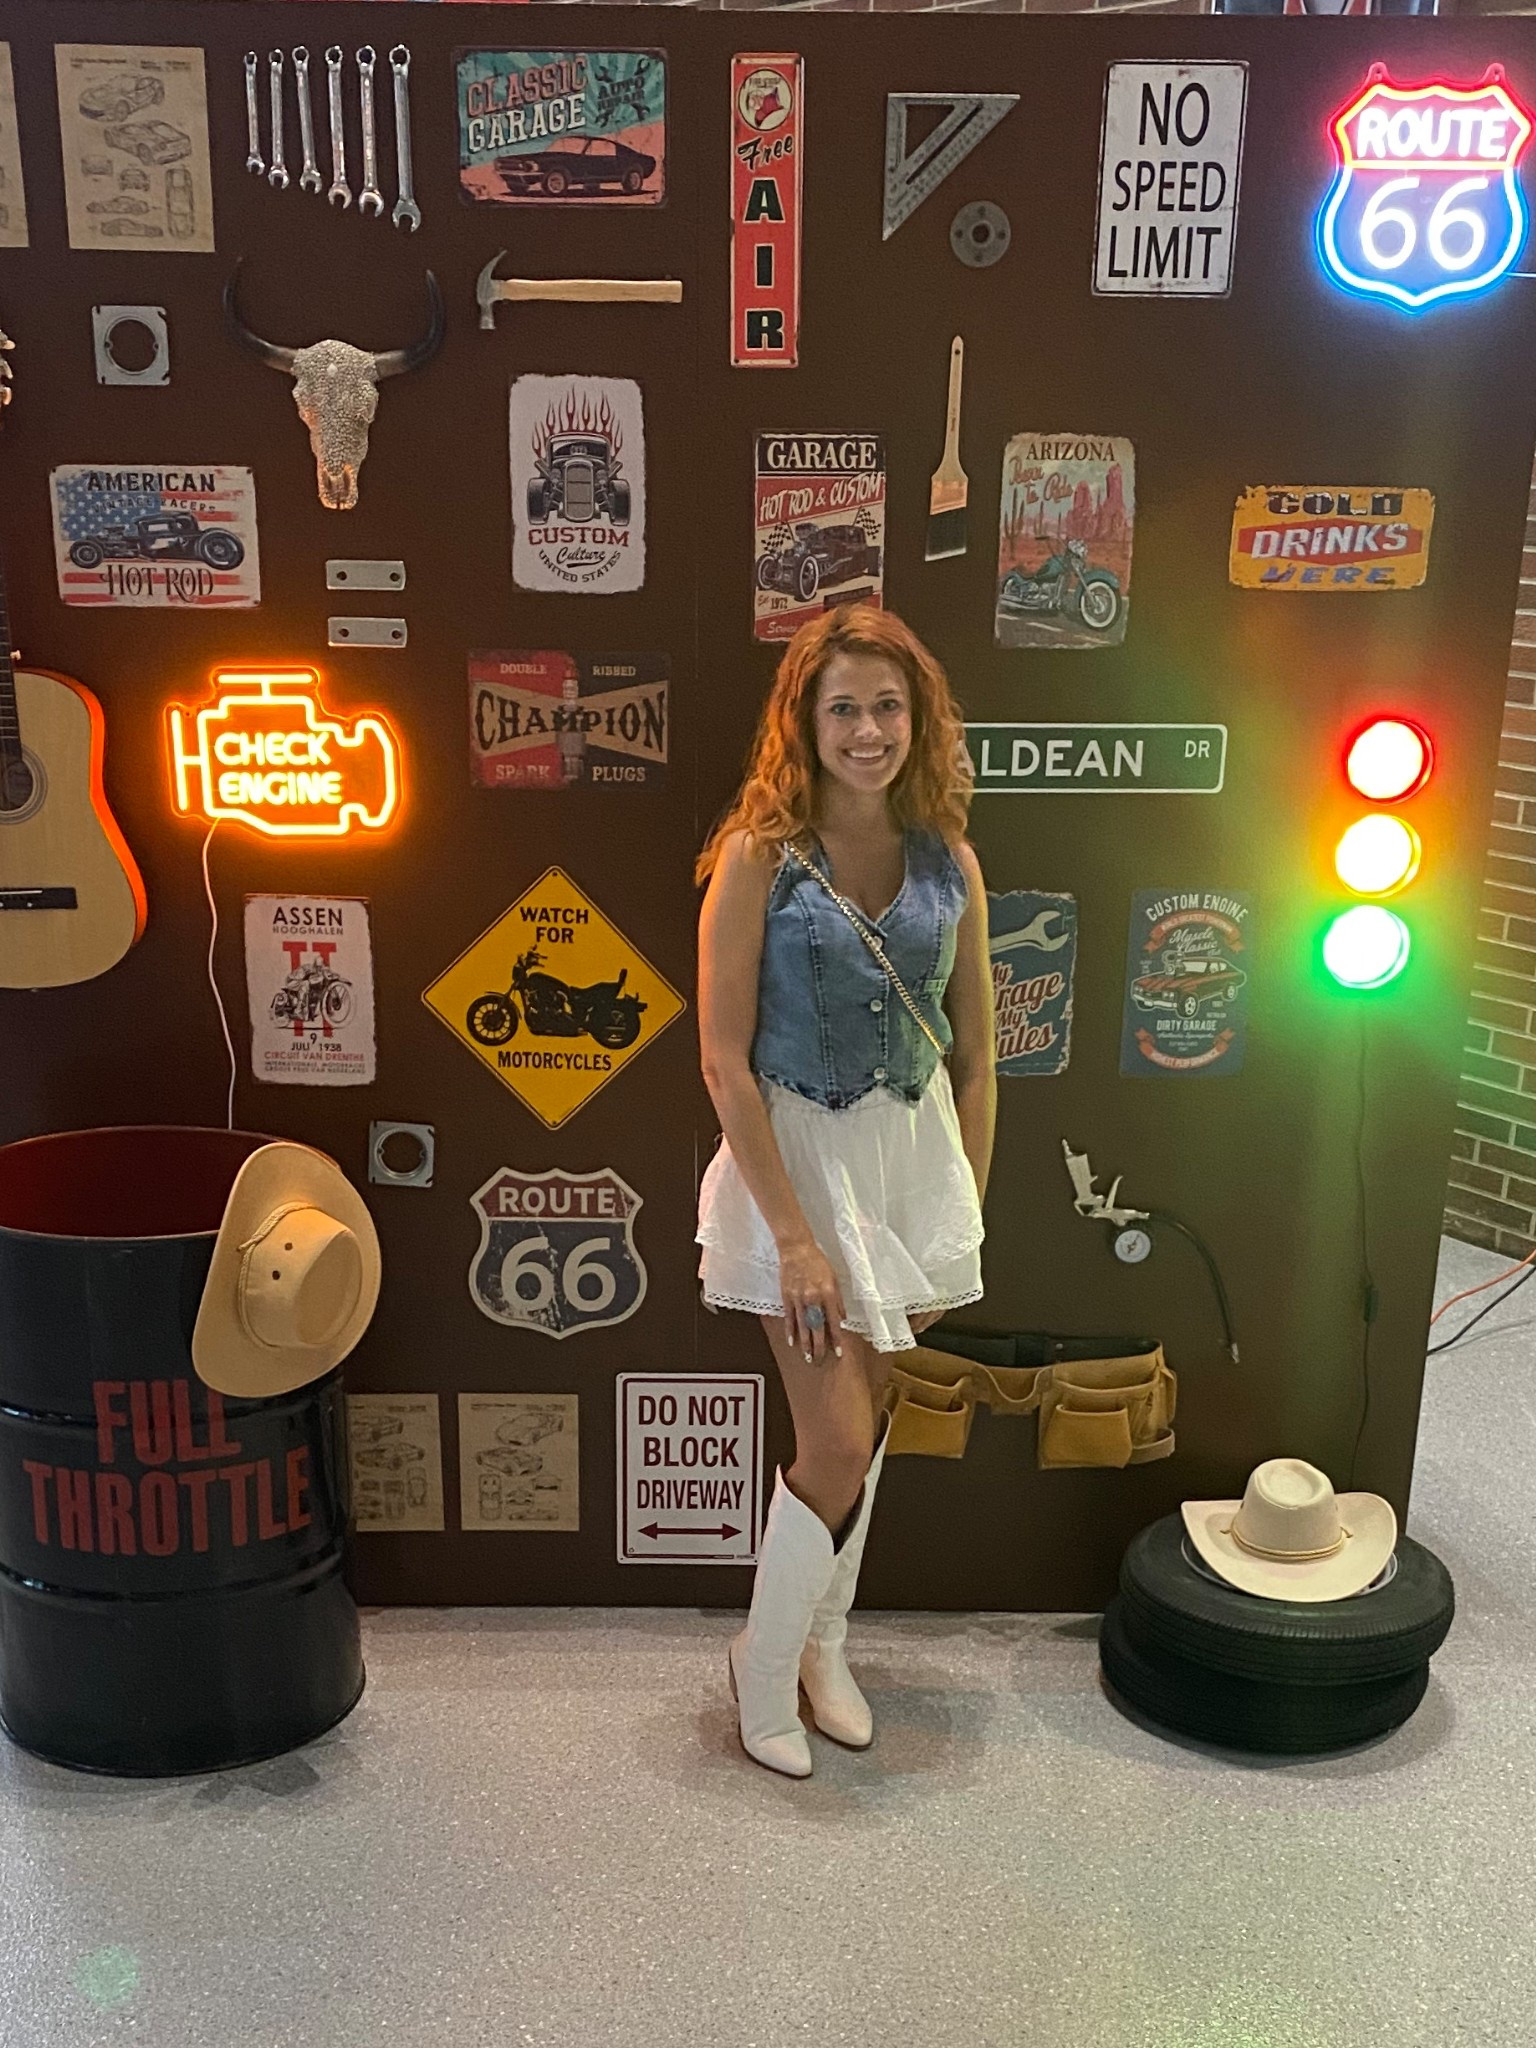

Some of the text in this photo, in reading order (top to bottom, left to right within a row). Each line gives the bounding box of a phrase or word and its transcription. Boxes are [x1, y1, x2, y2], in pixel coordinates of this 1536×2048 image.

[467, 57, 588, 118] CLASSIC
[467, 92, 587, 153] GARAGE
[1138, 82, 1210, 147] NO
[1356, 107, 1510, 158] ROUTE
[737, 136, 793, 170] Free
[1112, 160, 1227, 212] SPEED
[1360, 176, 1489, 270] 66
[744, 178, 785, 349] AIR
[1107, 225, 1222, 279] LIMIT
[766, 441, 877, 469] GARAGE
[1026, 442, 1116, 461] ARIZONA
[87, 472, 216, 492] AMERICAN
[759, 471, 885, 522] HOT ROD & CUSTOM
[160, 498, 216, 514] RACERS
[528, 526, 631, 547] CUSTOM
[1251, 522, 1409, 559] DRINKS
[539, 549, 621, 582] UNITED STATES
[556, 546, 606, 566] Culture
[100, 564, 214, 603] HOT ROD
[500, 663, 636, 676] DOUBLE RIBBED
[475, 689, 666, 753] CHAMPION
[213, 731, 331, 765] CHECK
[957, 738, 1211, 777] ALDEAN DR
[218, 771, 343, 806] ENGINE
[495, 764, 646, 782] SPARK PLUGS
[272, 906, 343, 926] ASSEN
[520, 906, 589, 924] WATCH
[1145, 893, 1200, 922] CUSTOM
[1202, 894, 1249, 923] ENGINE
[536, 926, 574, 943] FOR
[994, 974, 1060, 1011] rage
[309, 1032, 318, 1045] 9
[996, 1024, 1054, 1059] ules
[1156, 1019, 1218, 1031] DIRTY GARAGE
[303, 1052, 322, 1060] VAN
[319, 1043, 342, 1052] 1938
[497, 1051, 612, 1071] MOTORCYCLES
[499, 1186, 616, 1214] ROUTE
[501, 1236, 616, 1312] 66
[93, 1379, 242, 1466] FULL
[638, 1395, 746, 1427] DO NOT
[643, 1437, 740, 1467] BLOCK
[22, 1445, 313, 1557] THROTTLE
[637, 1479, 745, 1510] DRIVEWAY
